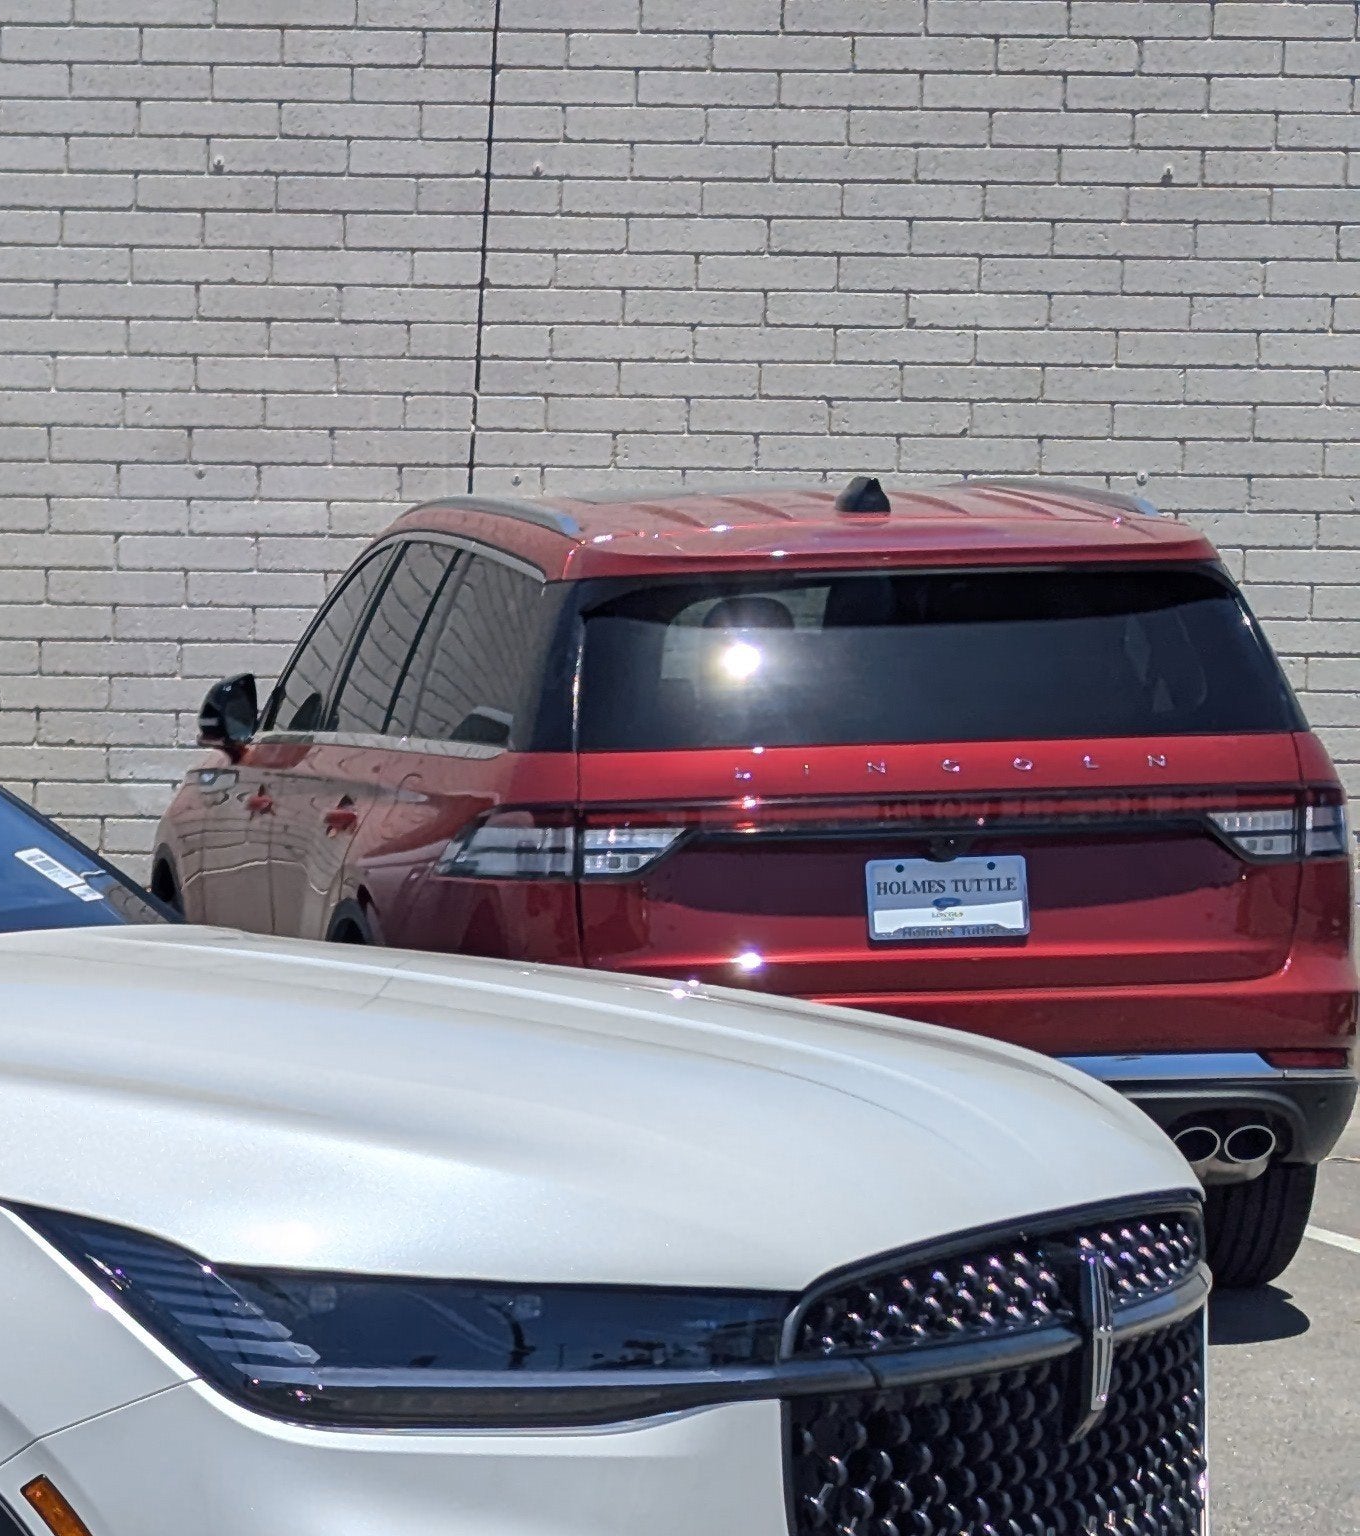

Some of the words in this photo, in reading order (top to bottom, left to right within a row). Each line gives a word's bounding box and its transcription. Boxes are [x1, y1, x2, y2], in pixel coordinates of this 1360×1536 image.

[733, 754, 1168, 780] LINCOLN
[875, 879, 946, 896] HOLMES
[951, 877, 1018, 893] TUTTLE
